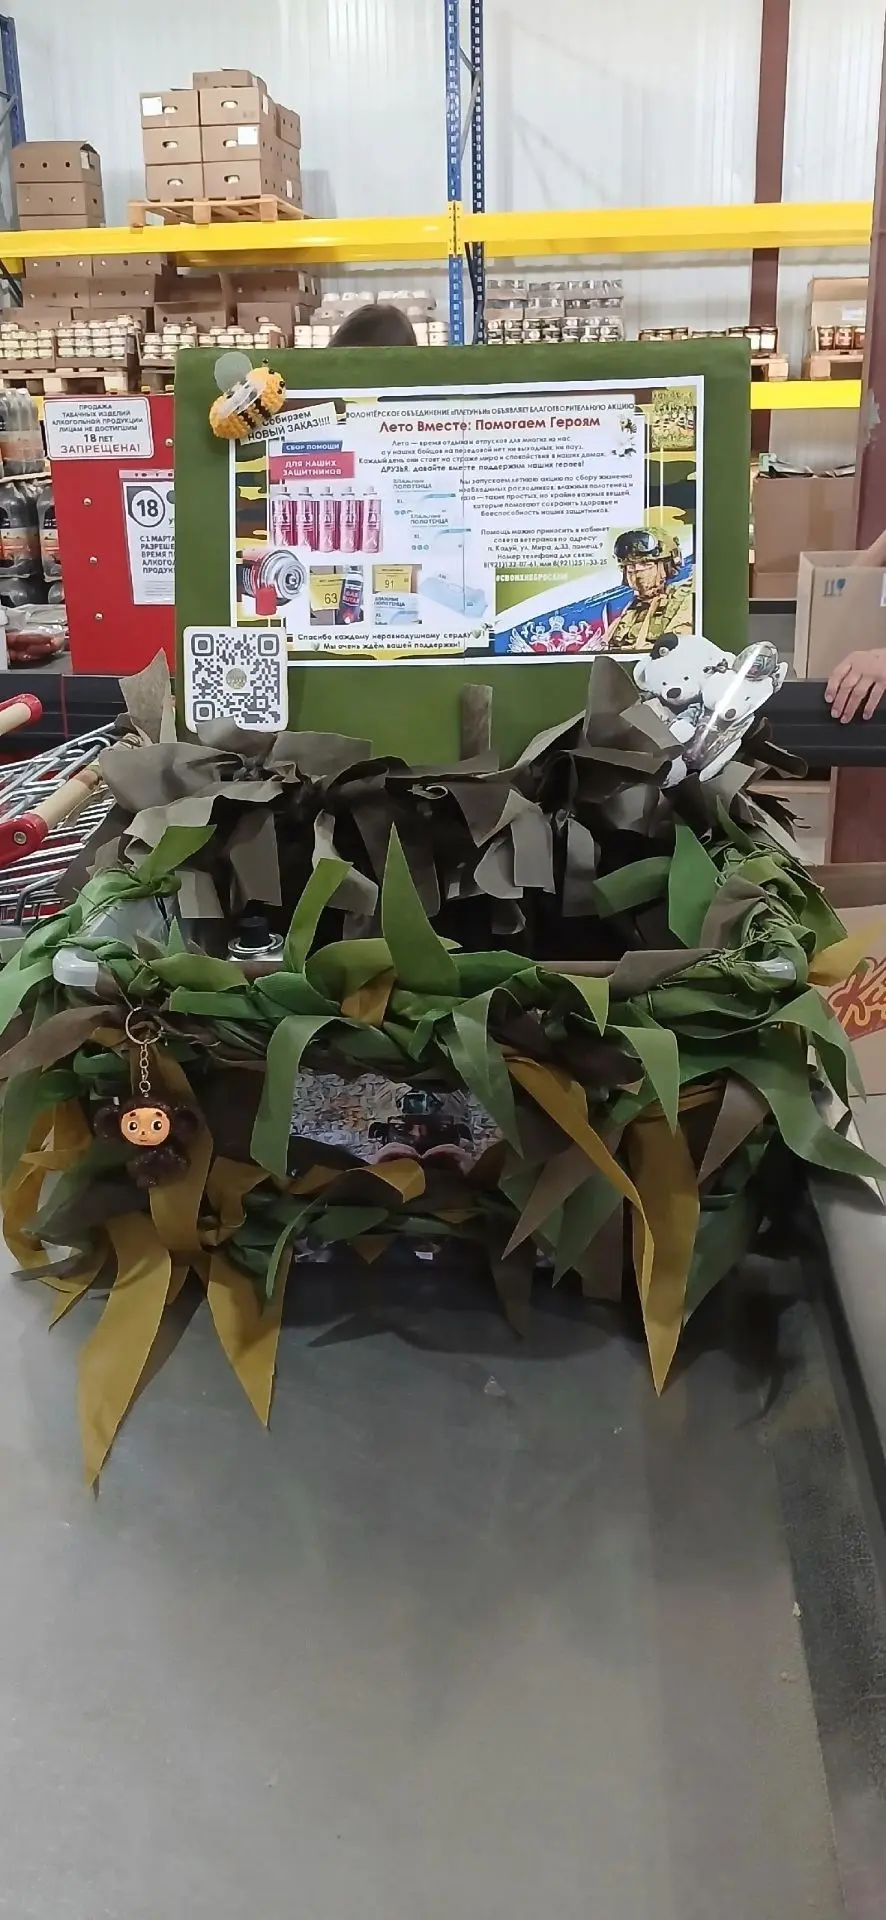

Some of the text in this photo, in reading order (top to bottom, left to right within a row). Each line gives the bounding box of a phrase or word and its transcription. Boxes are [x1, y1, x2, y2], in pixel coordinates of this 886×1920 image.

[401, 409, 450, 417] ОБЪЕДИНЕНИЕ
[492, 406, 528, 414] ОБЪЯВЛЯЕТ
[530, 404, 606, 413] БЛАГОТВОРИТЕЛЬНУЮ
[608, 403, 634, 411] АКЦИЮ
[262, 410, 312, 427] Собираем
[380, 416, 600, 432] Лето Вместе: Помогаем Героям
[248, 416, 330, 440] НОВЫЙ ЗАКАЗ!!!!
[84, 434, 97, 442] 18
[60, 444, 140, 454] ЗАПРЕЩЕНА!
[136, 499, 159, 517] 18
[384, 579, 394, 589] 91
[324, 593, 338, 604] 63
